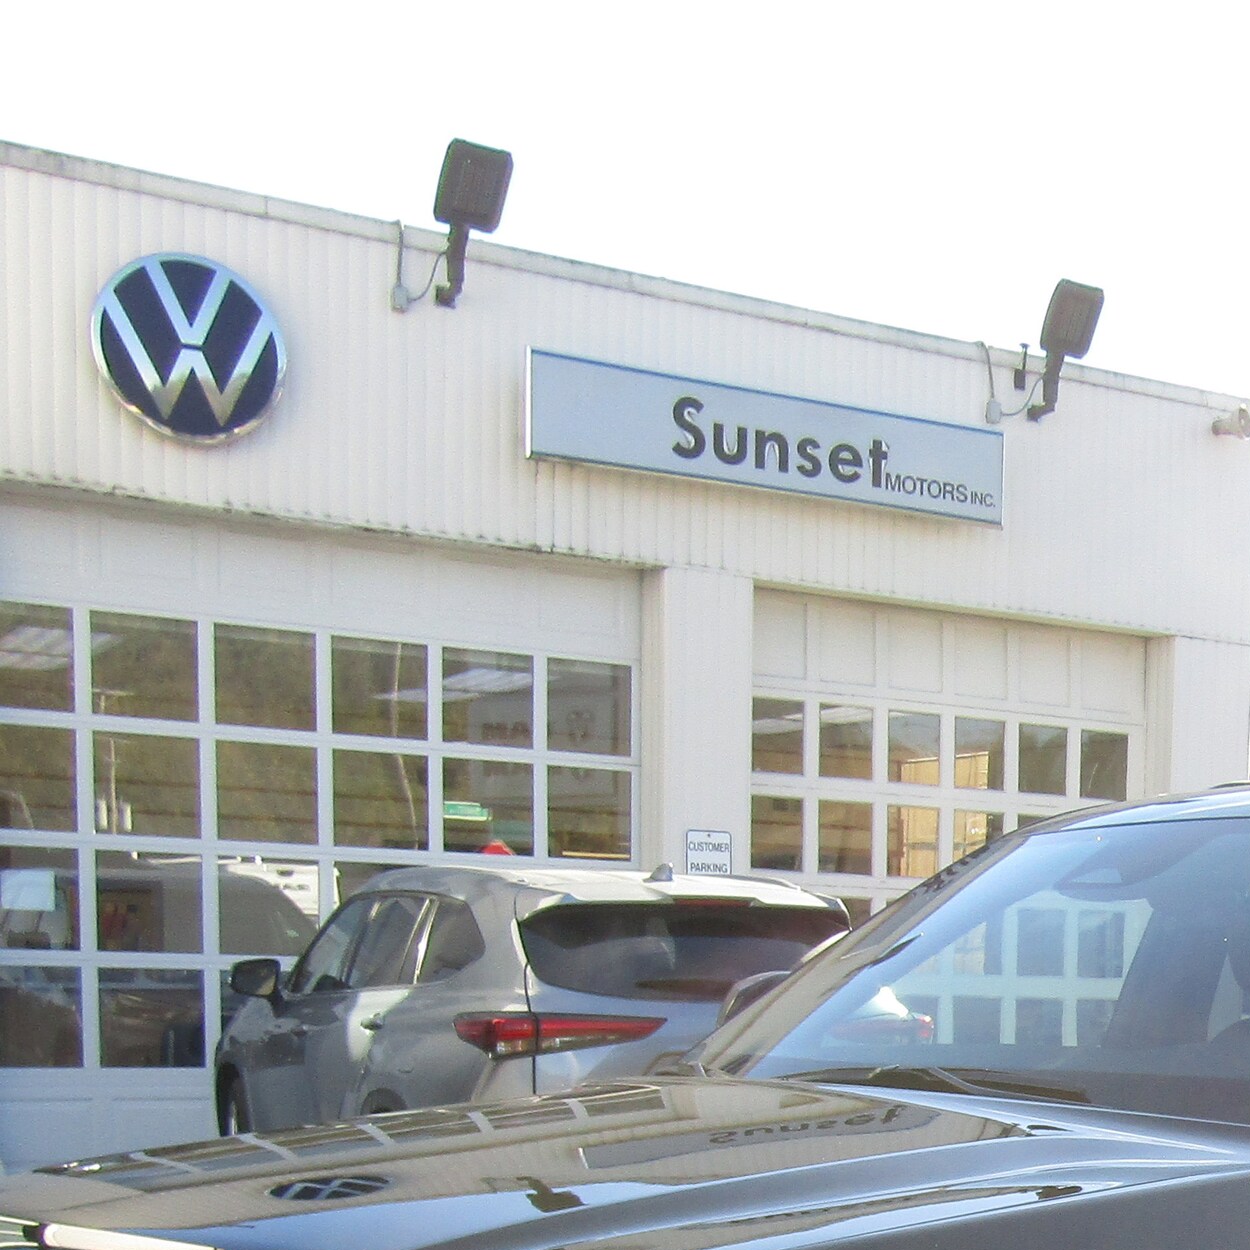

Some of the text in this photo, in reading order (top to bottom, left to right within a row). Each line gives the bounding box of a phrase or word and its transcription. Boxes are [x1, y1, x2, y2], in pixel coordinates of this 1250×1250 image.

[671, 396, 996, 509] Sunset MOTORS INC.
[689, 841, 730, 852] CUSTOMER
[690, 862, 728, 873] PARKING
